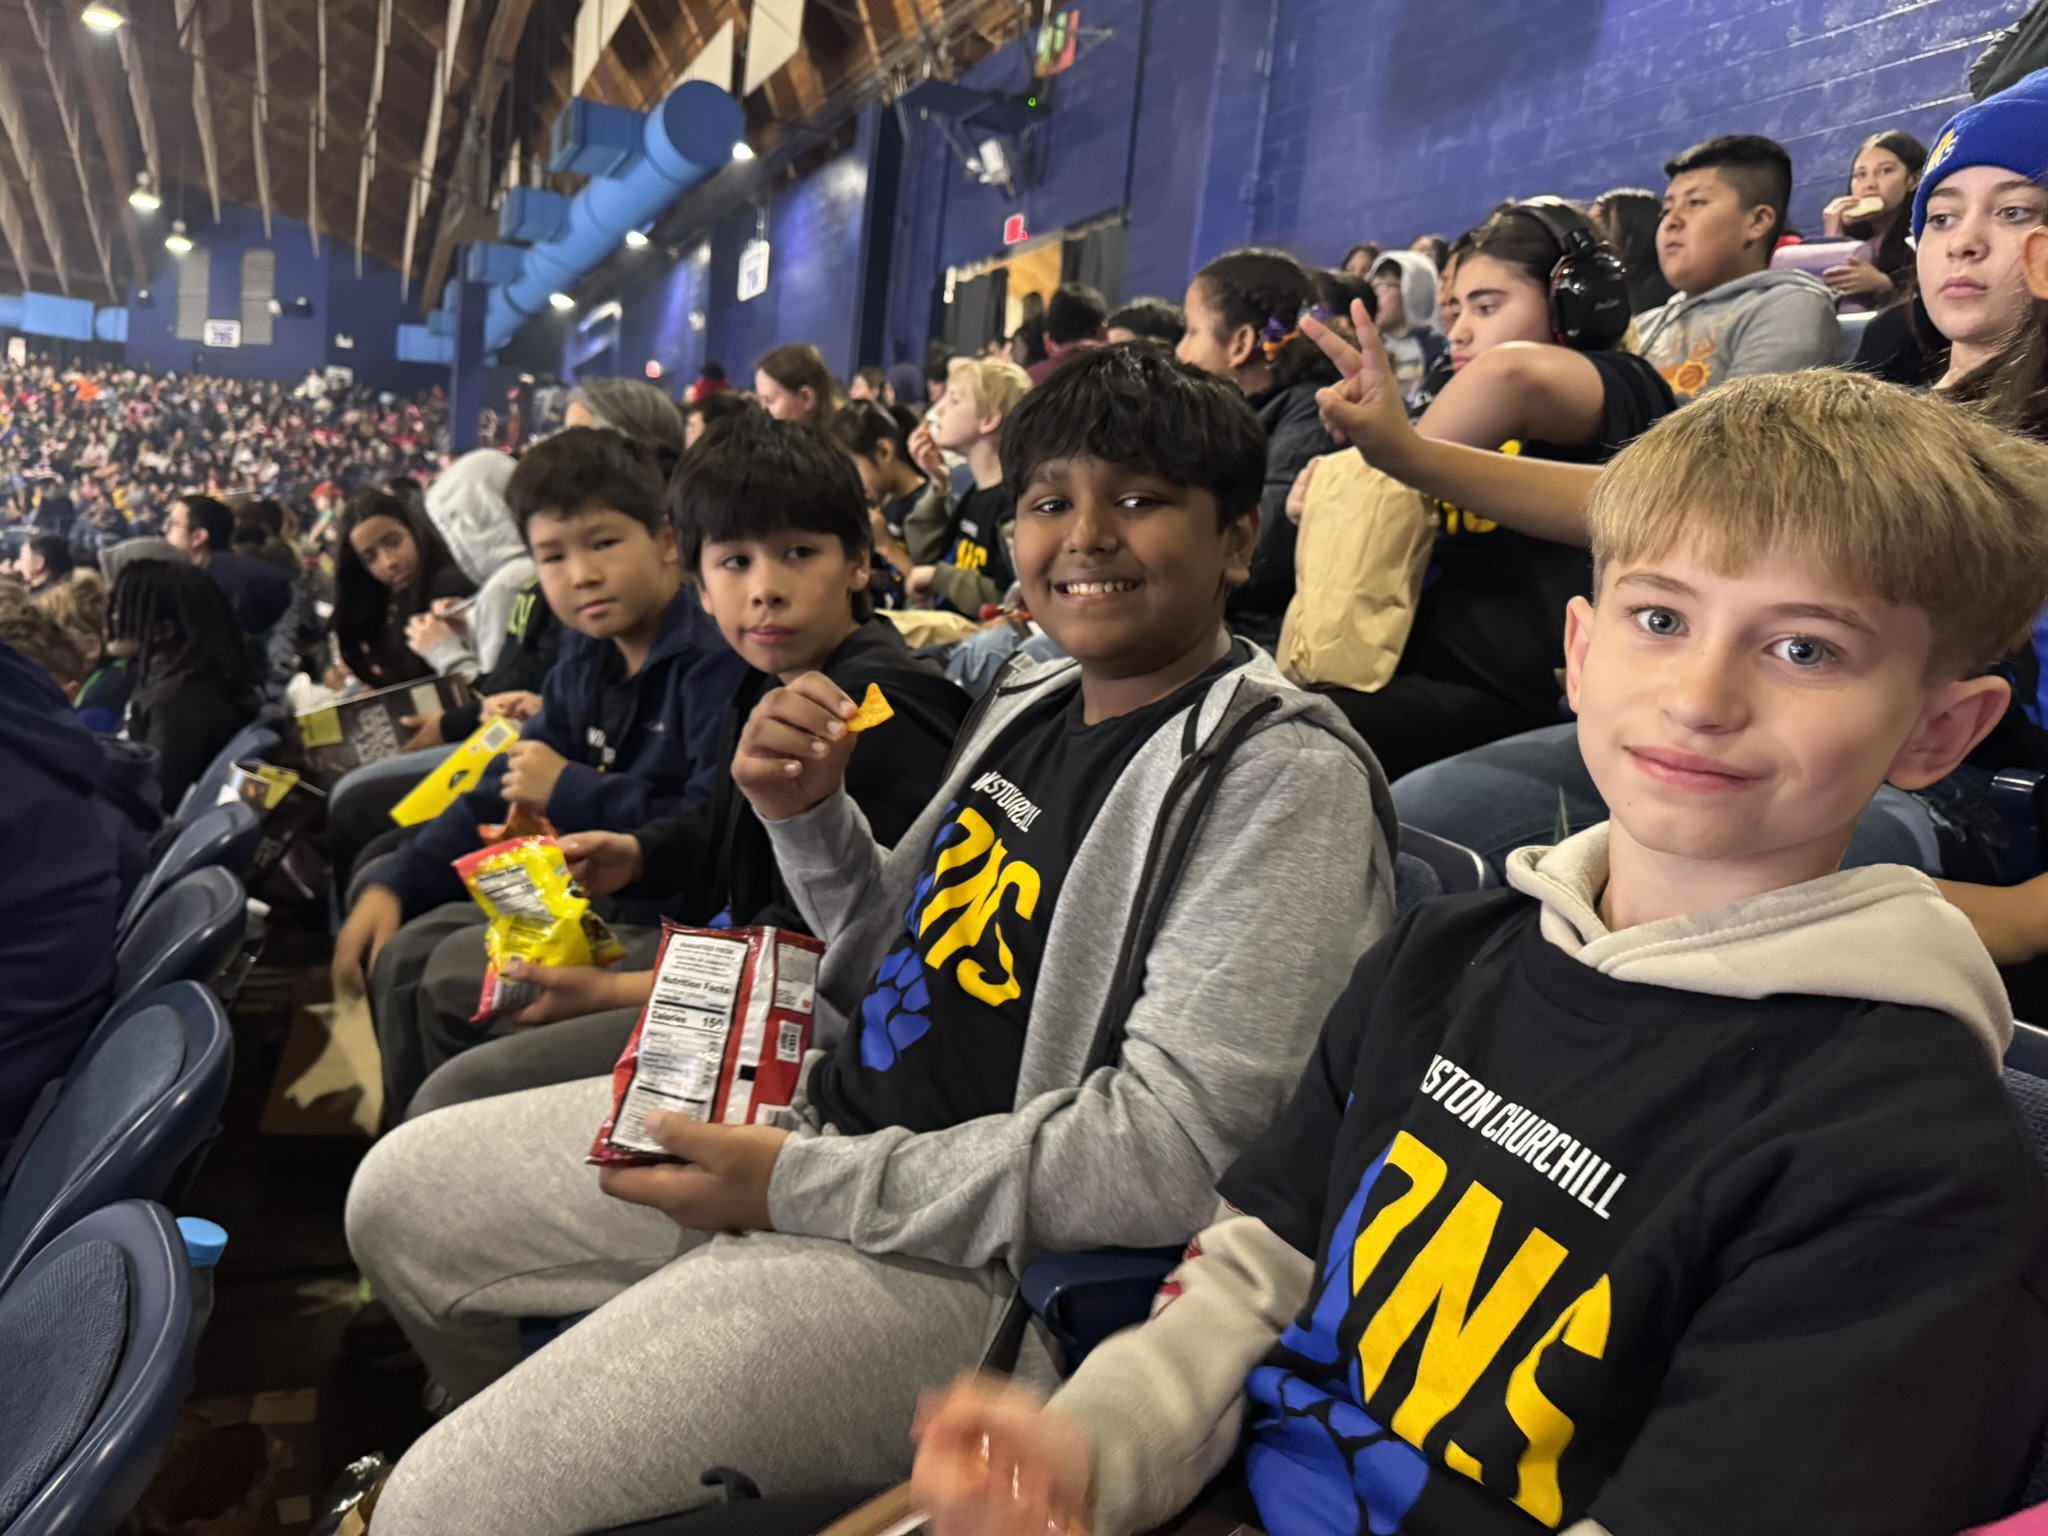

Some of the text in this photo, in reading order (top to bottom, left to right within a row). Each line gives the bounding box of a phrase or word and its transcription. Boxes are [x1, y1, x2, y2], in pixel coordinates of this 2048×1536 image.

[661, 975, 731, 995] Nutrition Facts
[651, 1010, 688, 1024] Calories
[1480, 1102, 1628, 1220] CHURCHILL
